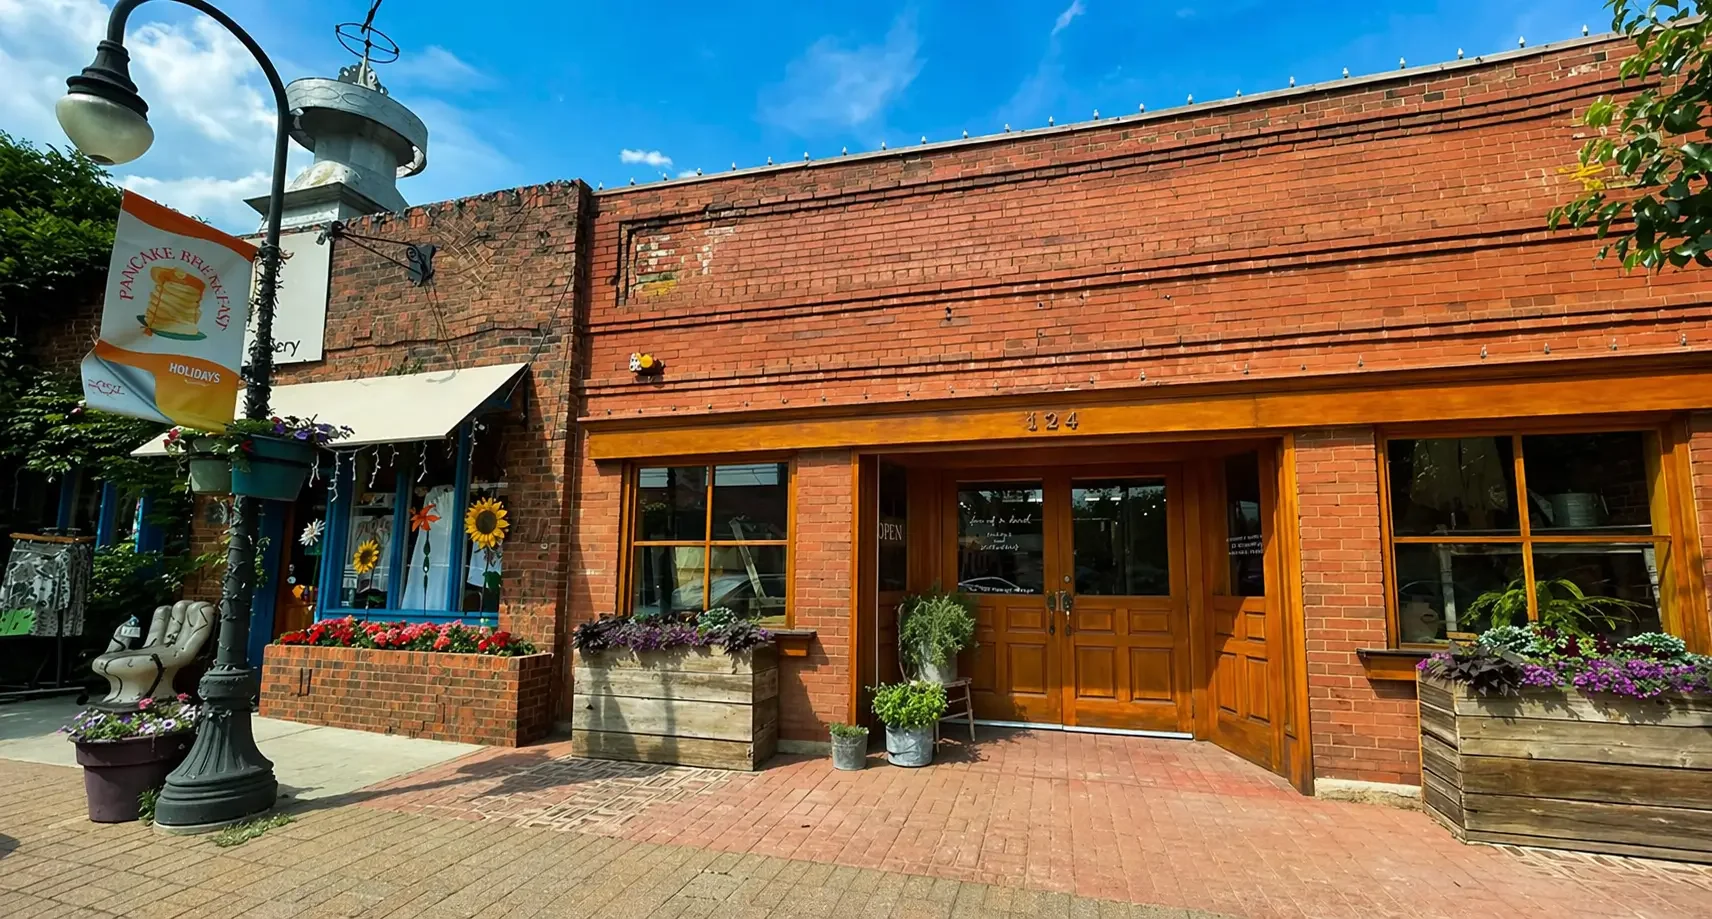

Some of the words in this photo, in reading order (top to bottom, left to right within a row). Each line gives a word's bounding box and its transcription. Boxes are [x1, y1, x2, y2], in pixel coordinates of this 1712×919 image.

[119, 247, 176, 301] PANCAKE
[273, 340, 301, 357] ery
[168, 362, 221, 384] HOLIDAYS
[1025, 411, 1079, 432] 124
[878, 522, 903, 541] OPEN
